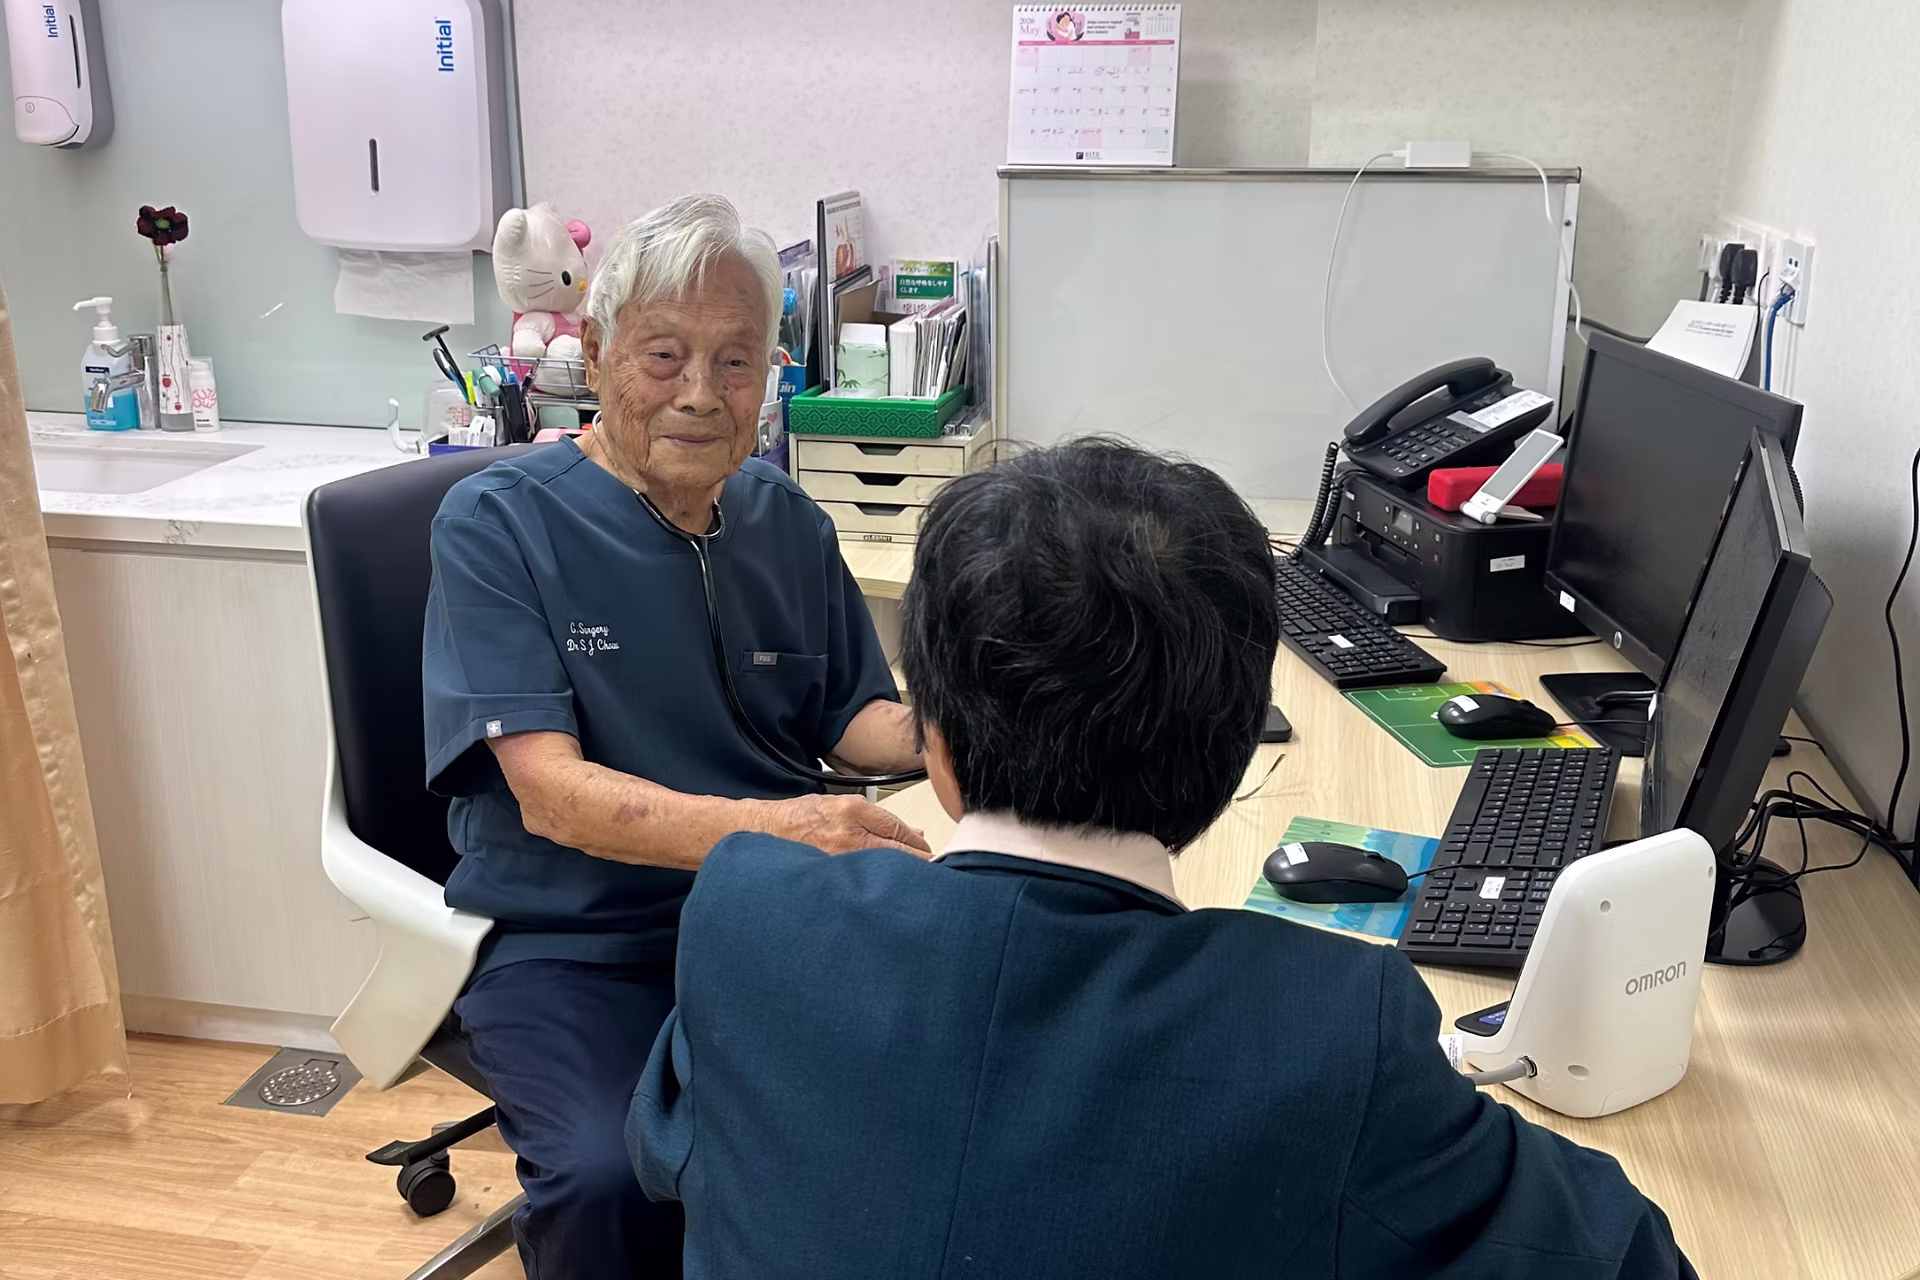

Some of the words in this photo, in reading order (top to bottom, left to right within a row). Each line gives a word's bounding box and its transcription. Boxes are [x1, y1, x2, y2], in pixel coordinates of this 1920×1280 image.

[43, 5, 59, 38] Initial
[1019, 17, 1035, 25] 2026
[1019, 25, 1039, 37] May
[435, 20, 455, 72] Initial
[1625, 961, 1686, 996] OMRON
